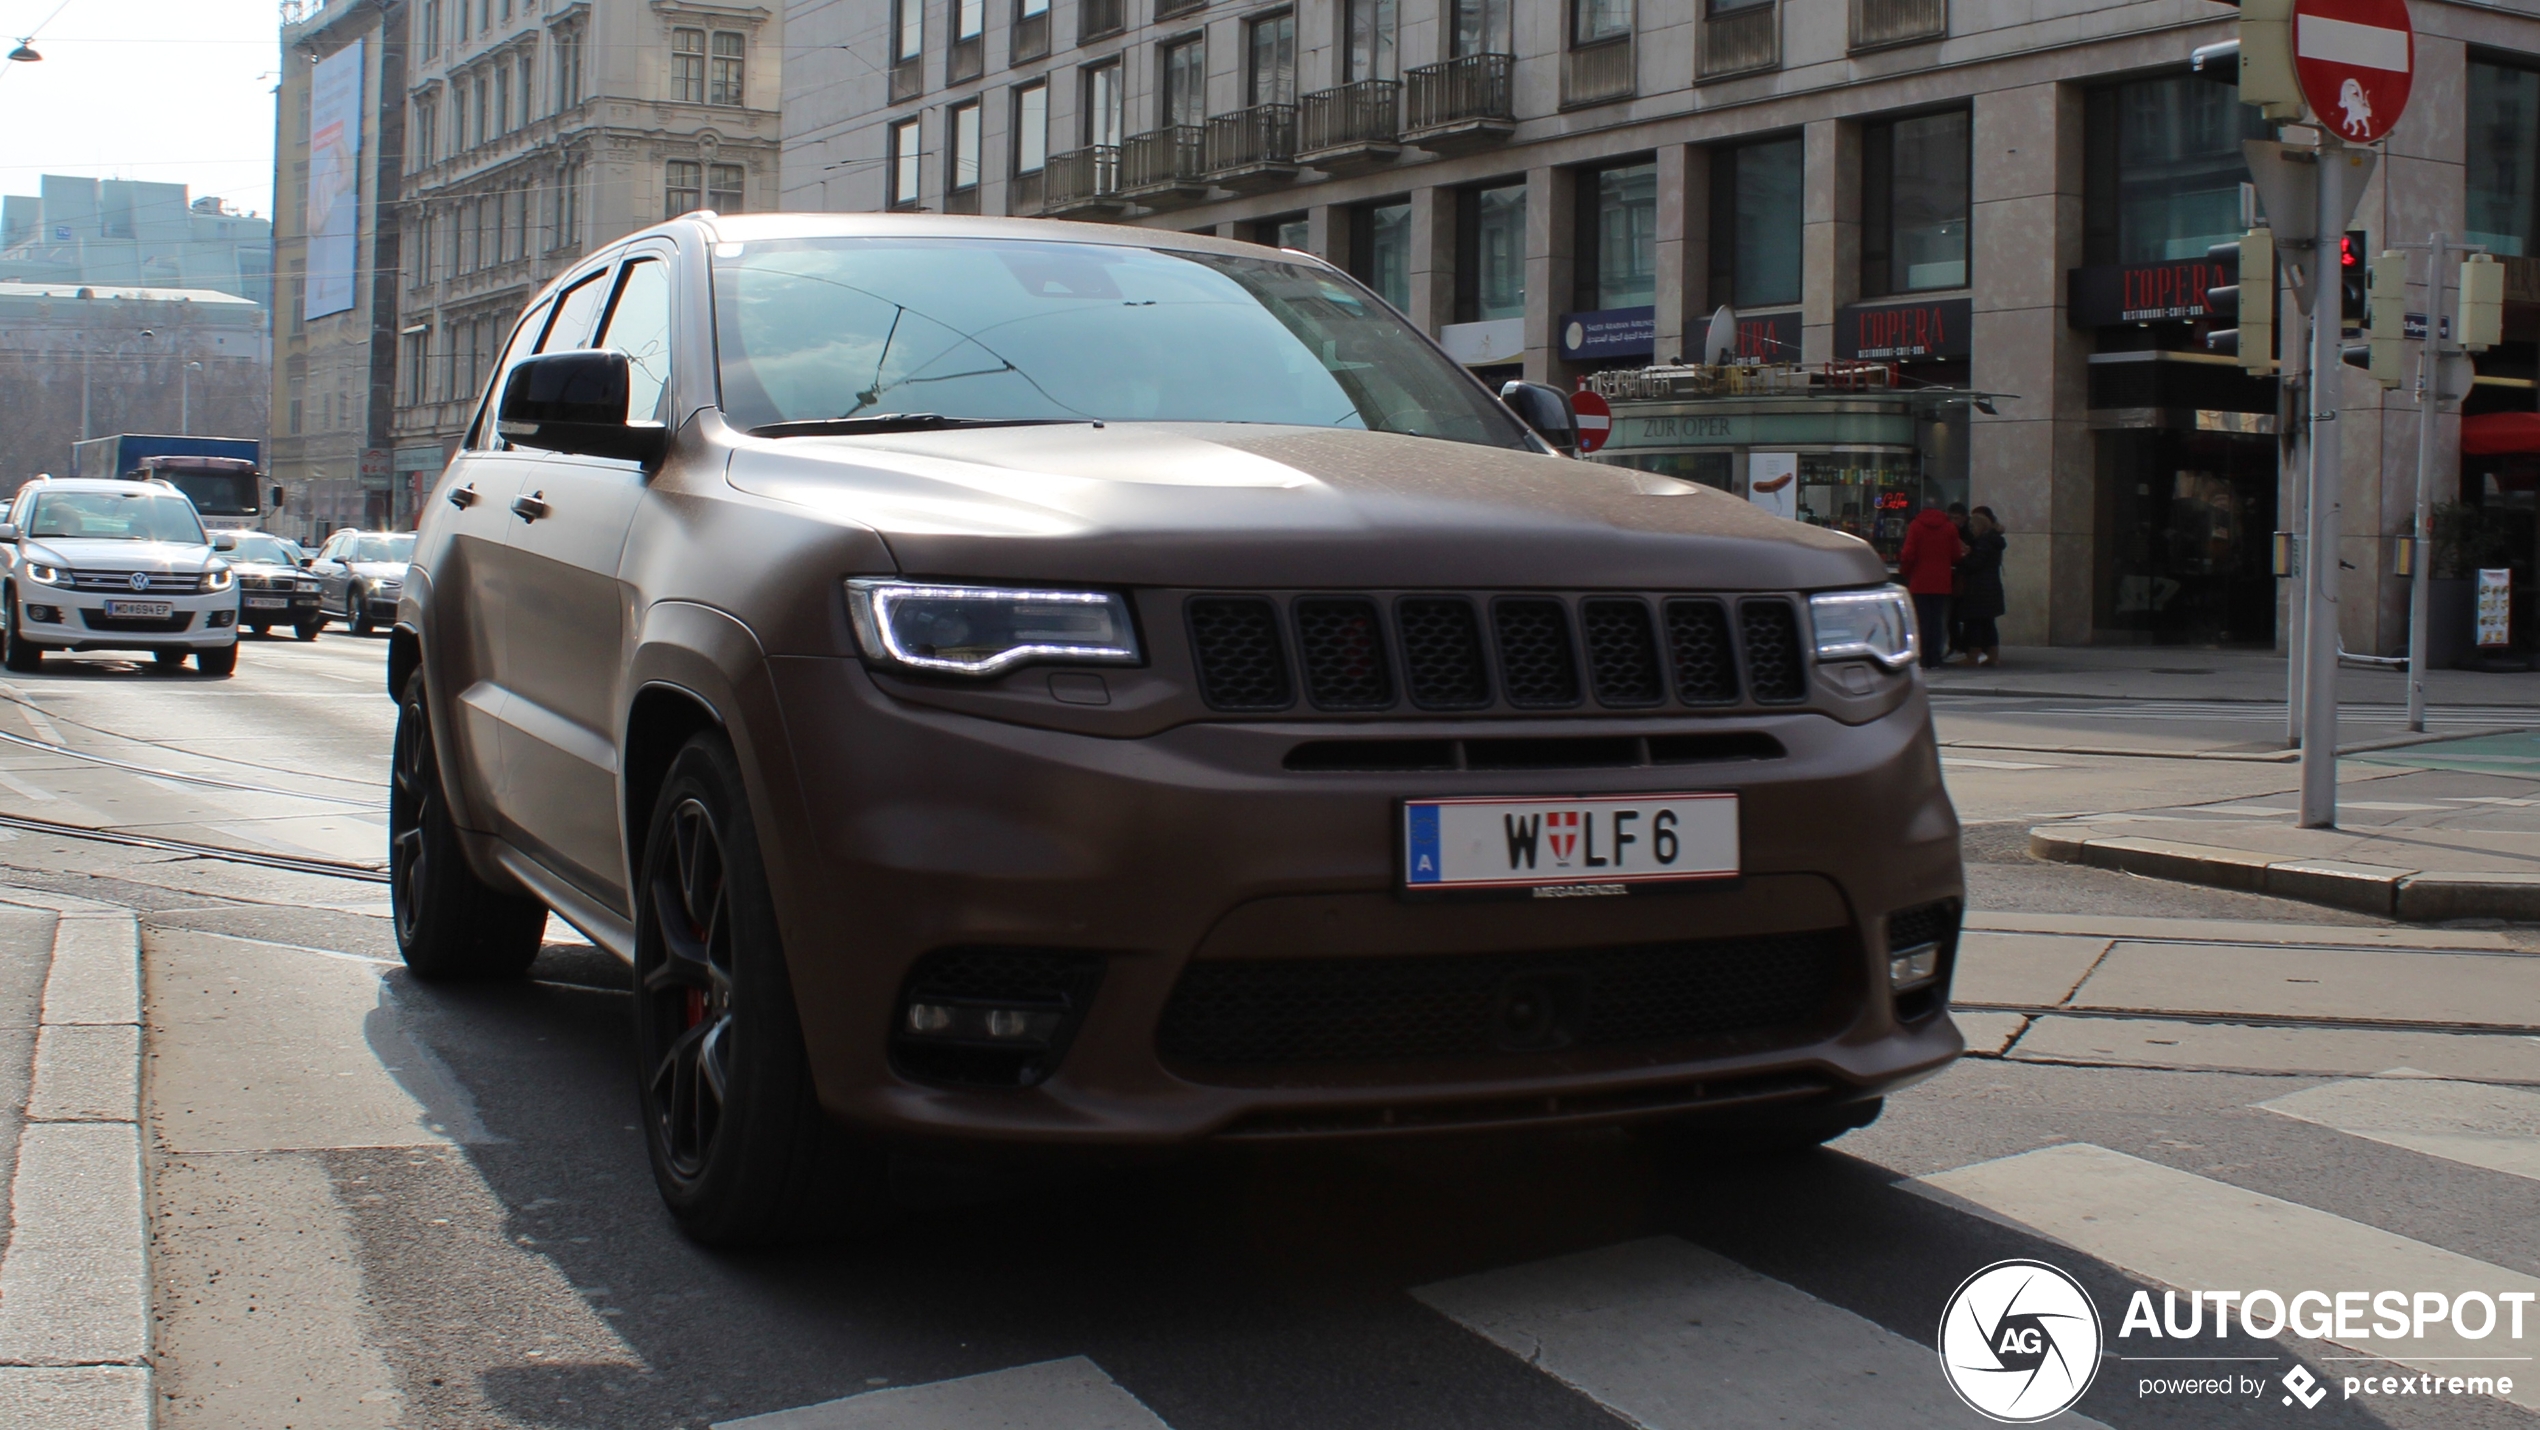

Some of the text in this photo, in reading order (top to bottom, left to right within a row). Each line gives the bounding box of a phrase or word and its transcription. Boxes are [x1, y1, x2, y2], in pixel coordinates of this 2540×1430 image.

[2124, 264, 2226, 312] L'OPERA
[1859, 307, 1945, 352] L'OPERA
[1643, 417, 1732, 438] ZUR OPER
[1417, 854, 1434, 872] A
